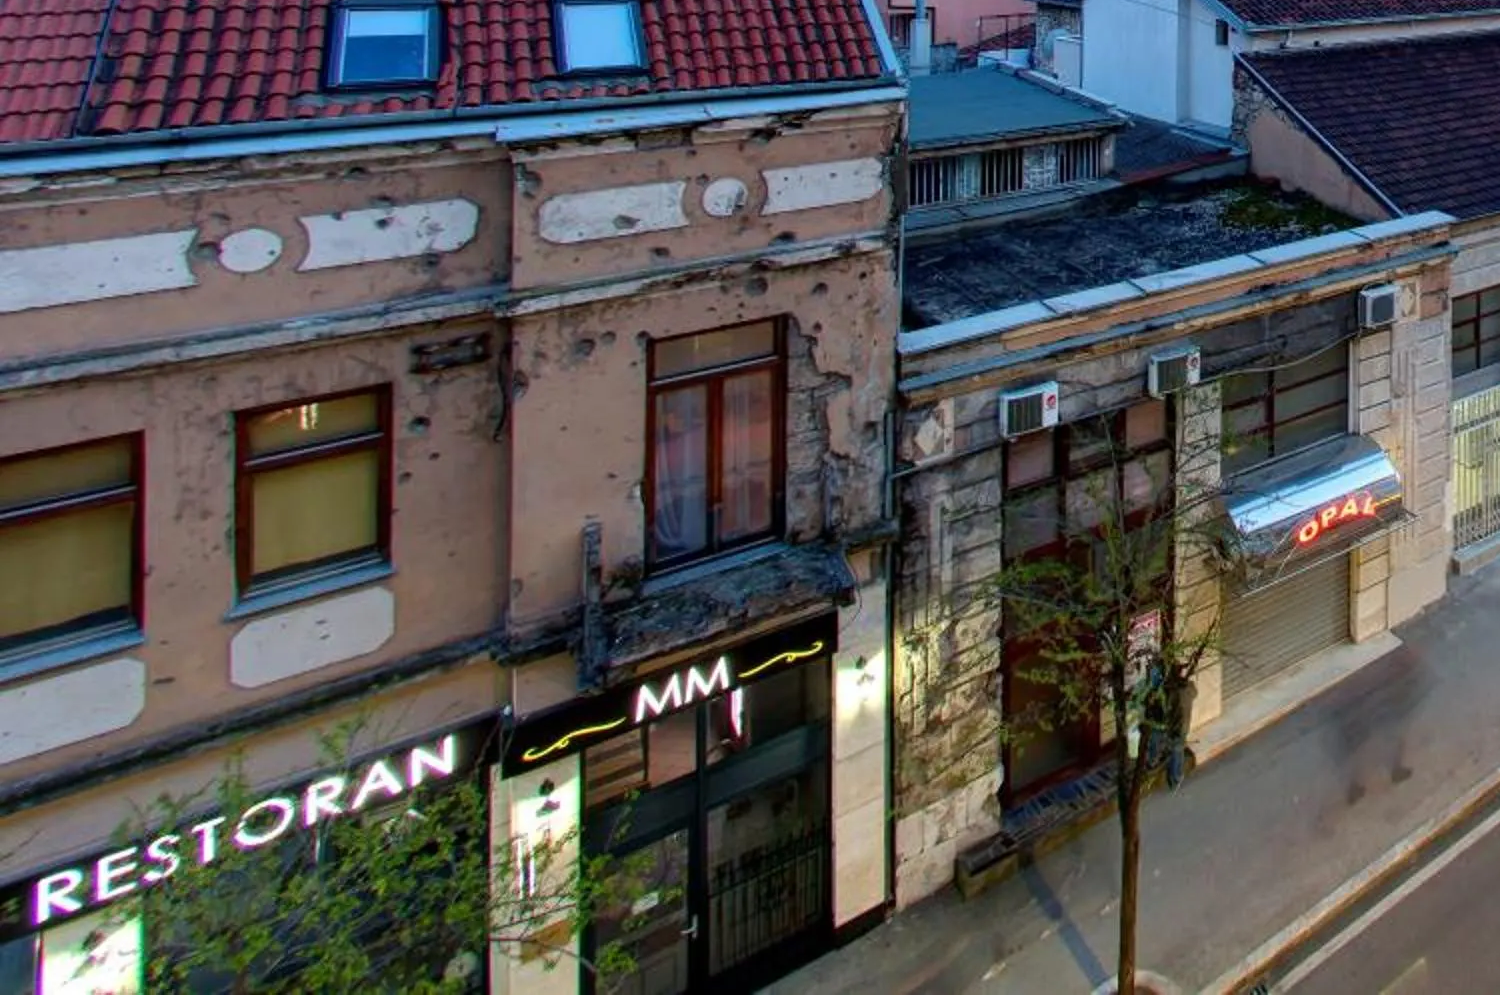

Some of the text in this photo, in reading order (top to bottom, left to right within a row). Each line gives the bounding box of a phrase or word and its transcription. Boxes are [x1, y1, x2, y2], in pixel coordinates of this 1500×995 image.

[1299, 495, 1376, 543] OPAL
[634, 656, 734, 723] MM
[34, 735, 458, 924] RESTORAN
